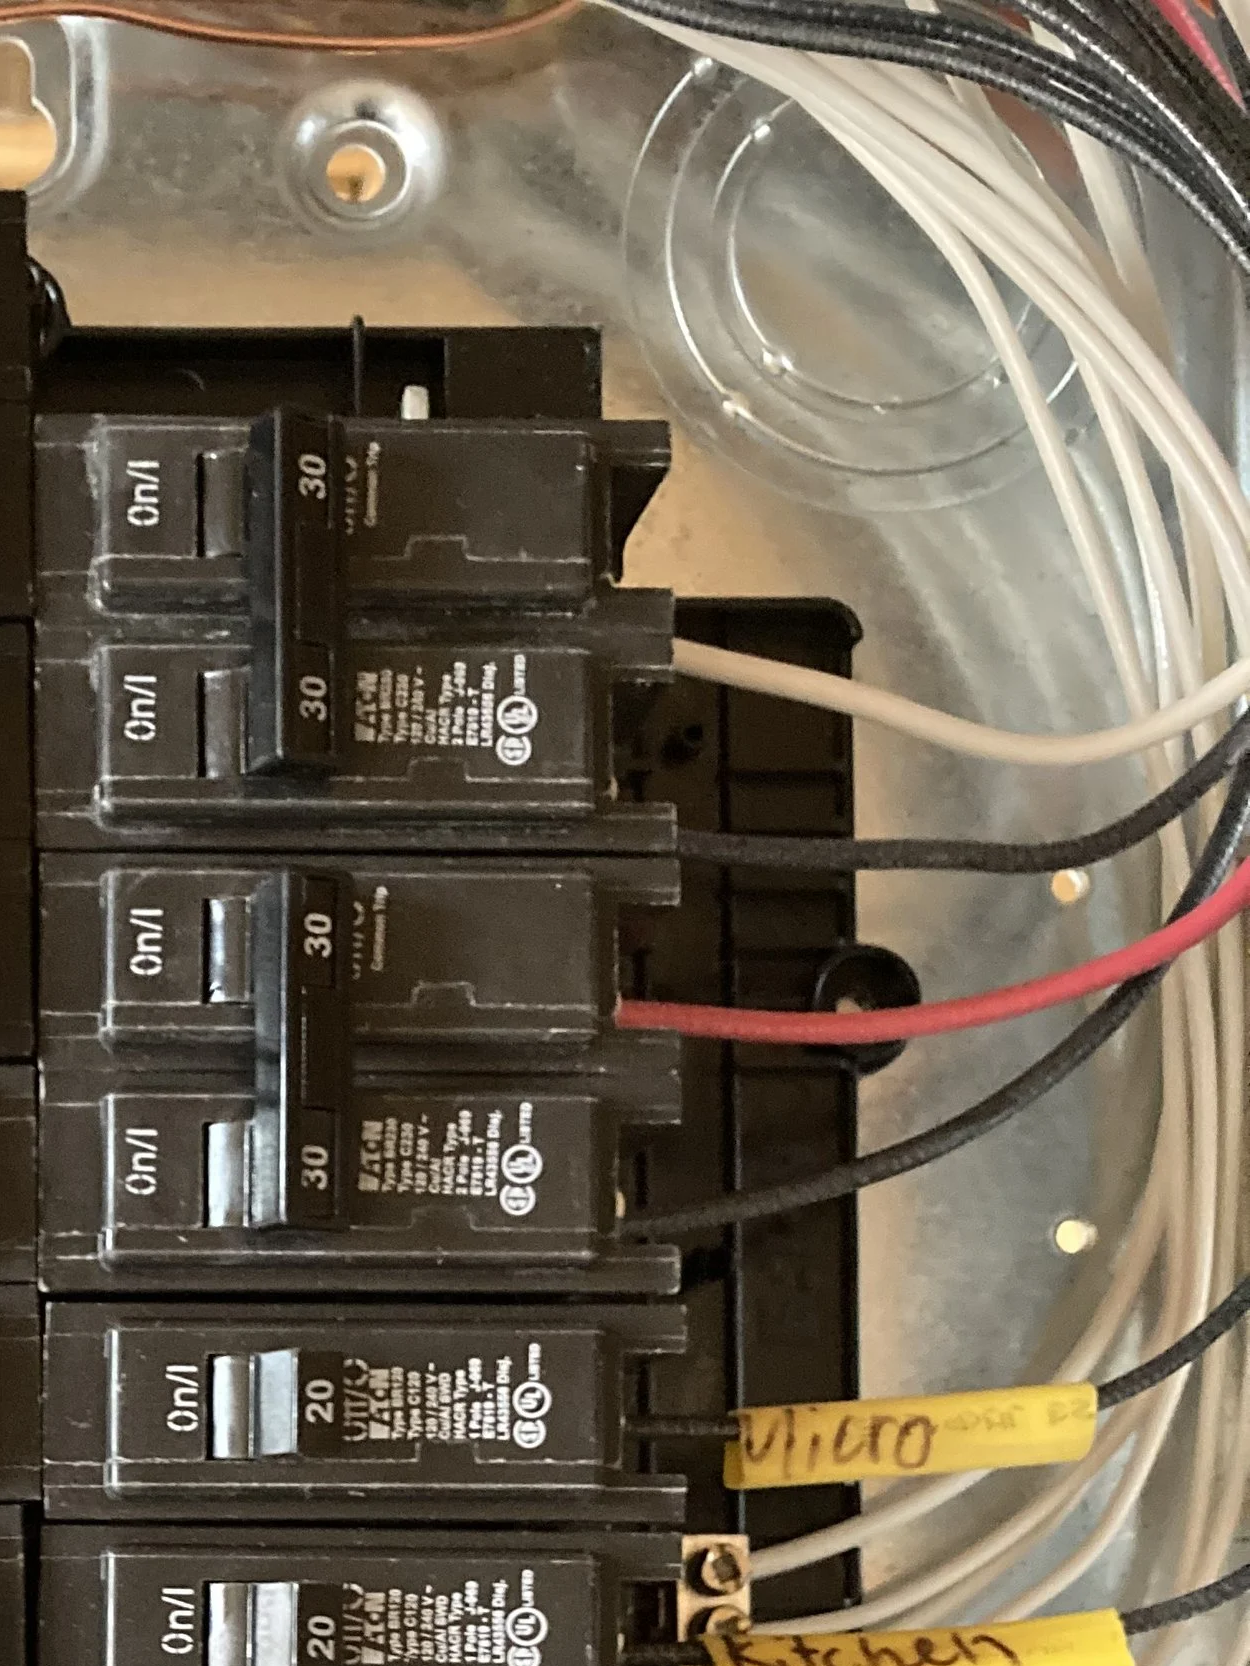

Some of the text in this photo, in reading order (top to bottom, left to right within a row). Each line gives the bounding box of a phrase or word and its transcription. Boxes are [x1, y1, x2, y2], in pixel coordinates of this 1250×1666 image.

[299, 455, 326, 499] 30
[300, 676, 326, 720] 30
[304, 913, 331, 957] 30
[302, 1146, 328, 1189] 30
[305, 1379, 335, 1423] 20
[307, 1616, 336, 1660] 20
